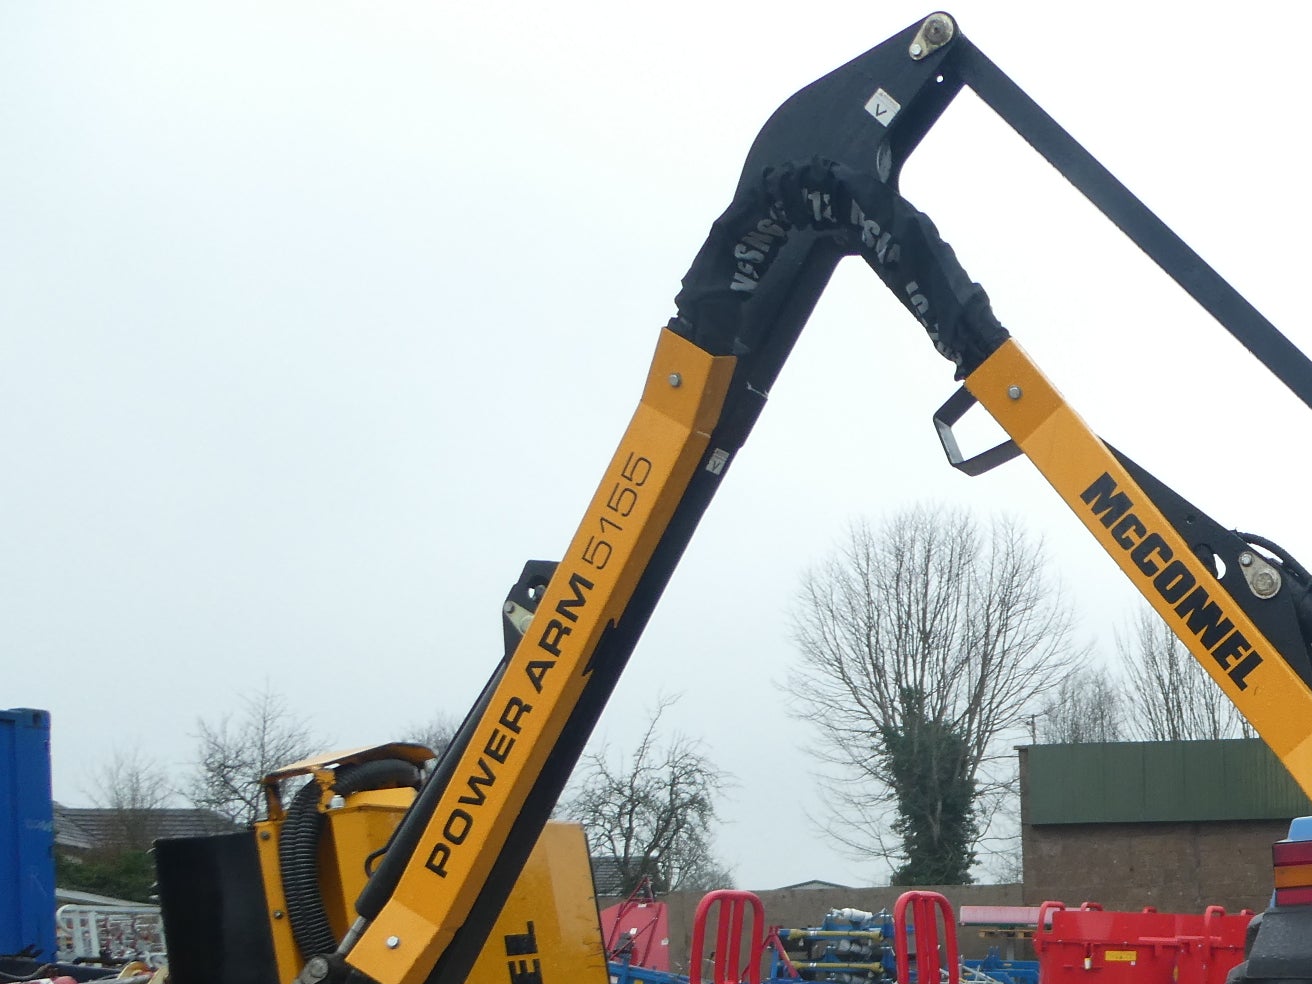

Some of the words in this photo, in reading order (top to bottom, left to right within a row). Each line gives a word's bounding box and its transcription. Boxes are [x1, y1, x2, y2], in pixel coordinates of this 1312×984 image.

[424, 695, 532, 879] POWER
[525, 572, 595, 694] ARM
[581, 450, 653, 570] 5155
